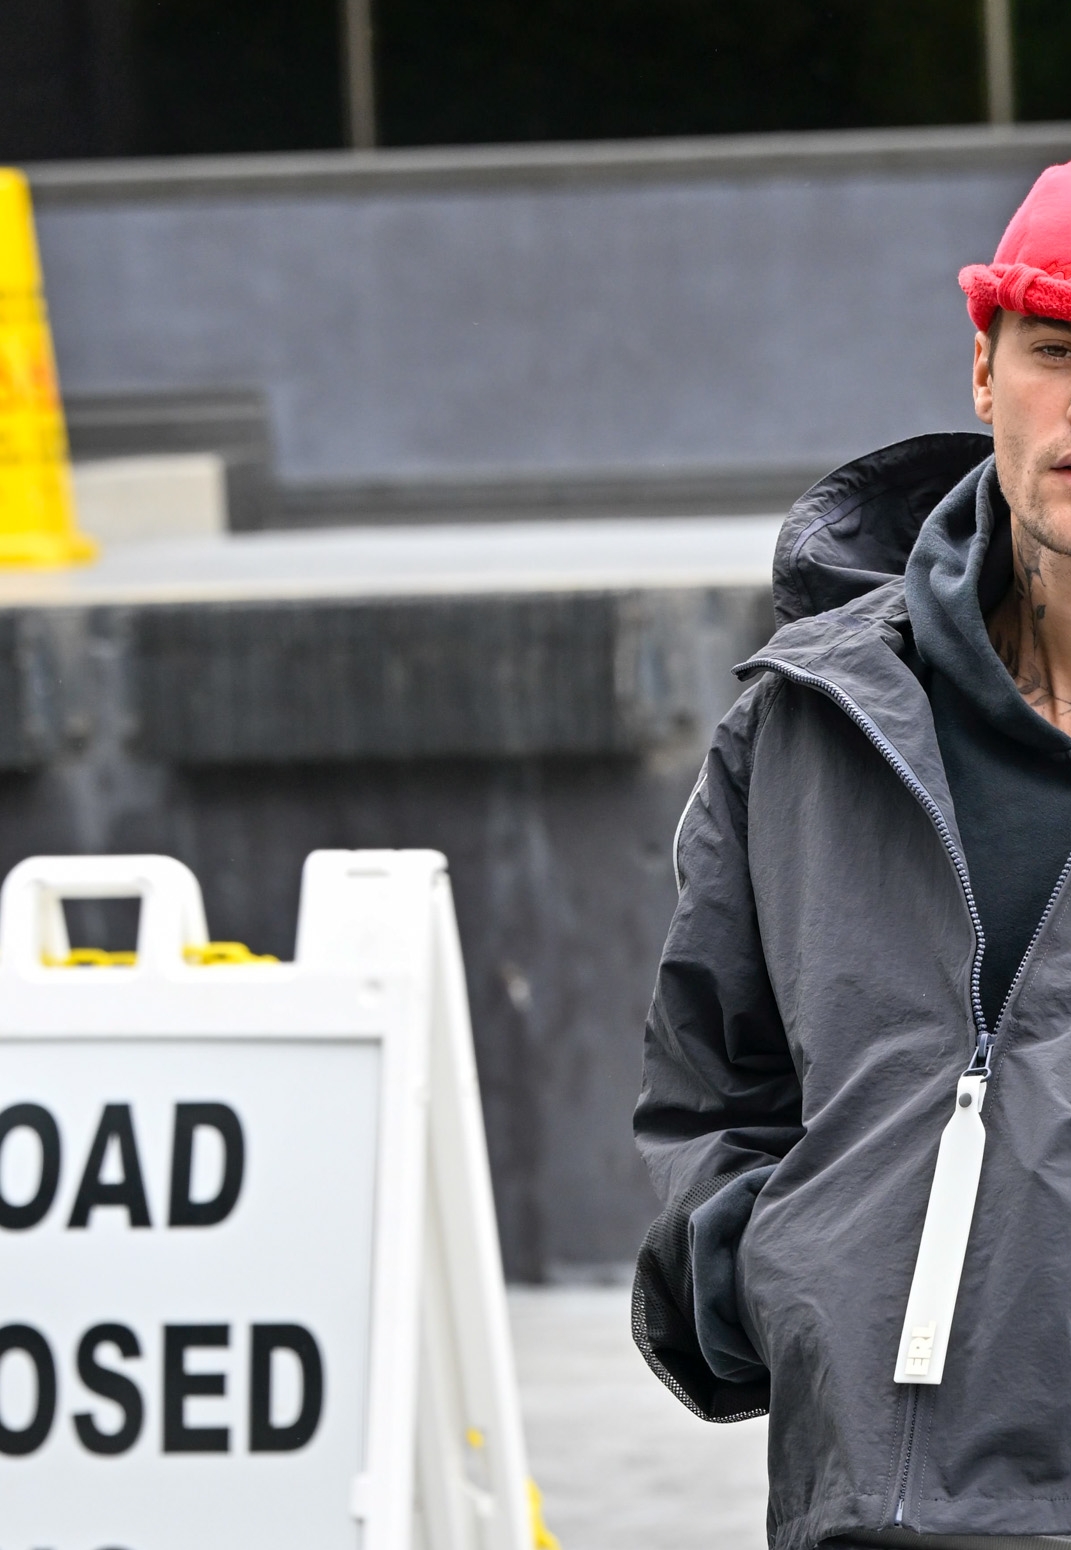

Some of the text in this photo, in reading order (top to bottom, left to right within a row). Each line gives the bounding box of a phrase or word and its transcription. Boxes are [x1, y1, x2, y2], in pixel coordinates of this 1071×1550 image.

[0, 1101, 246, 1231] OAD
[0, 1321, 324, 1456] OSED
[904, 1320, 937, 1376] ERL
